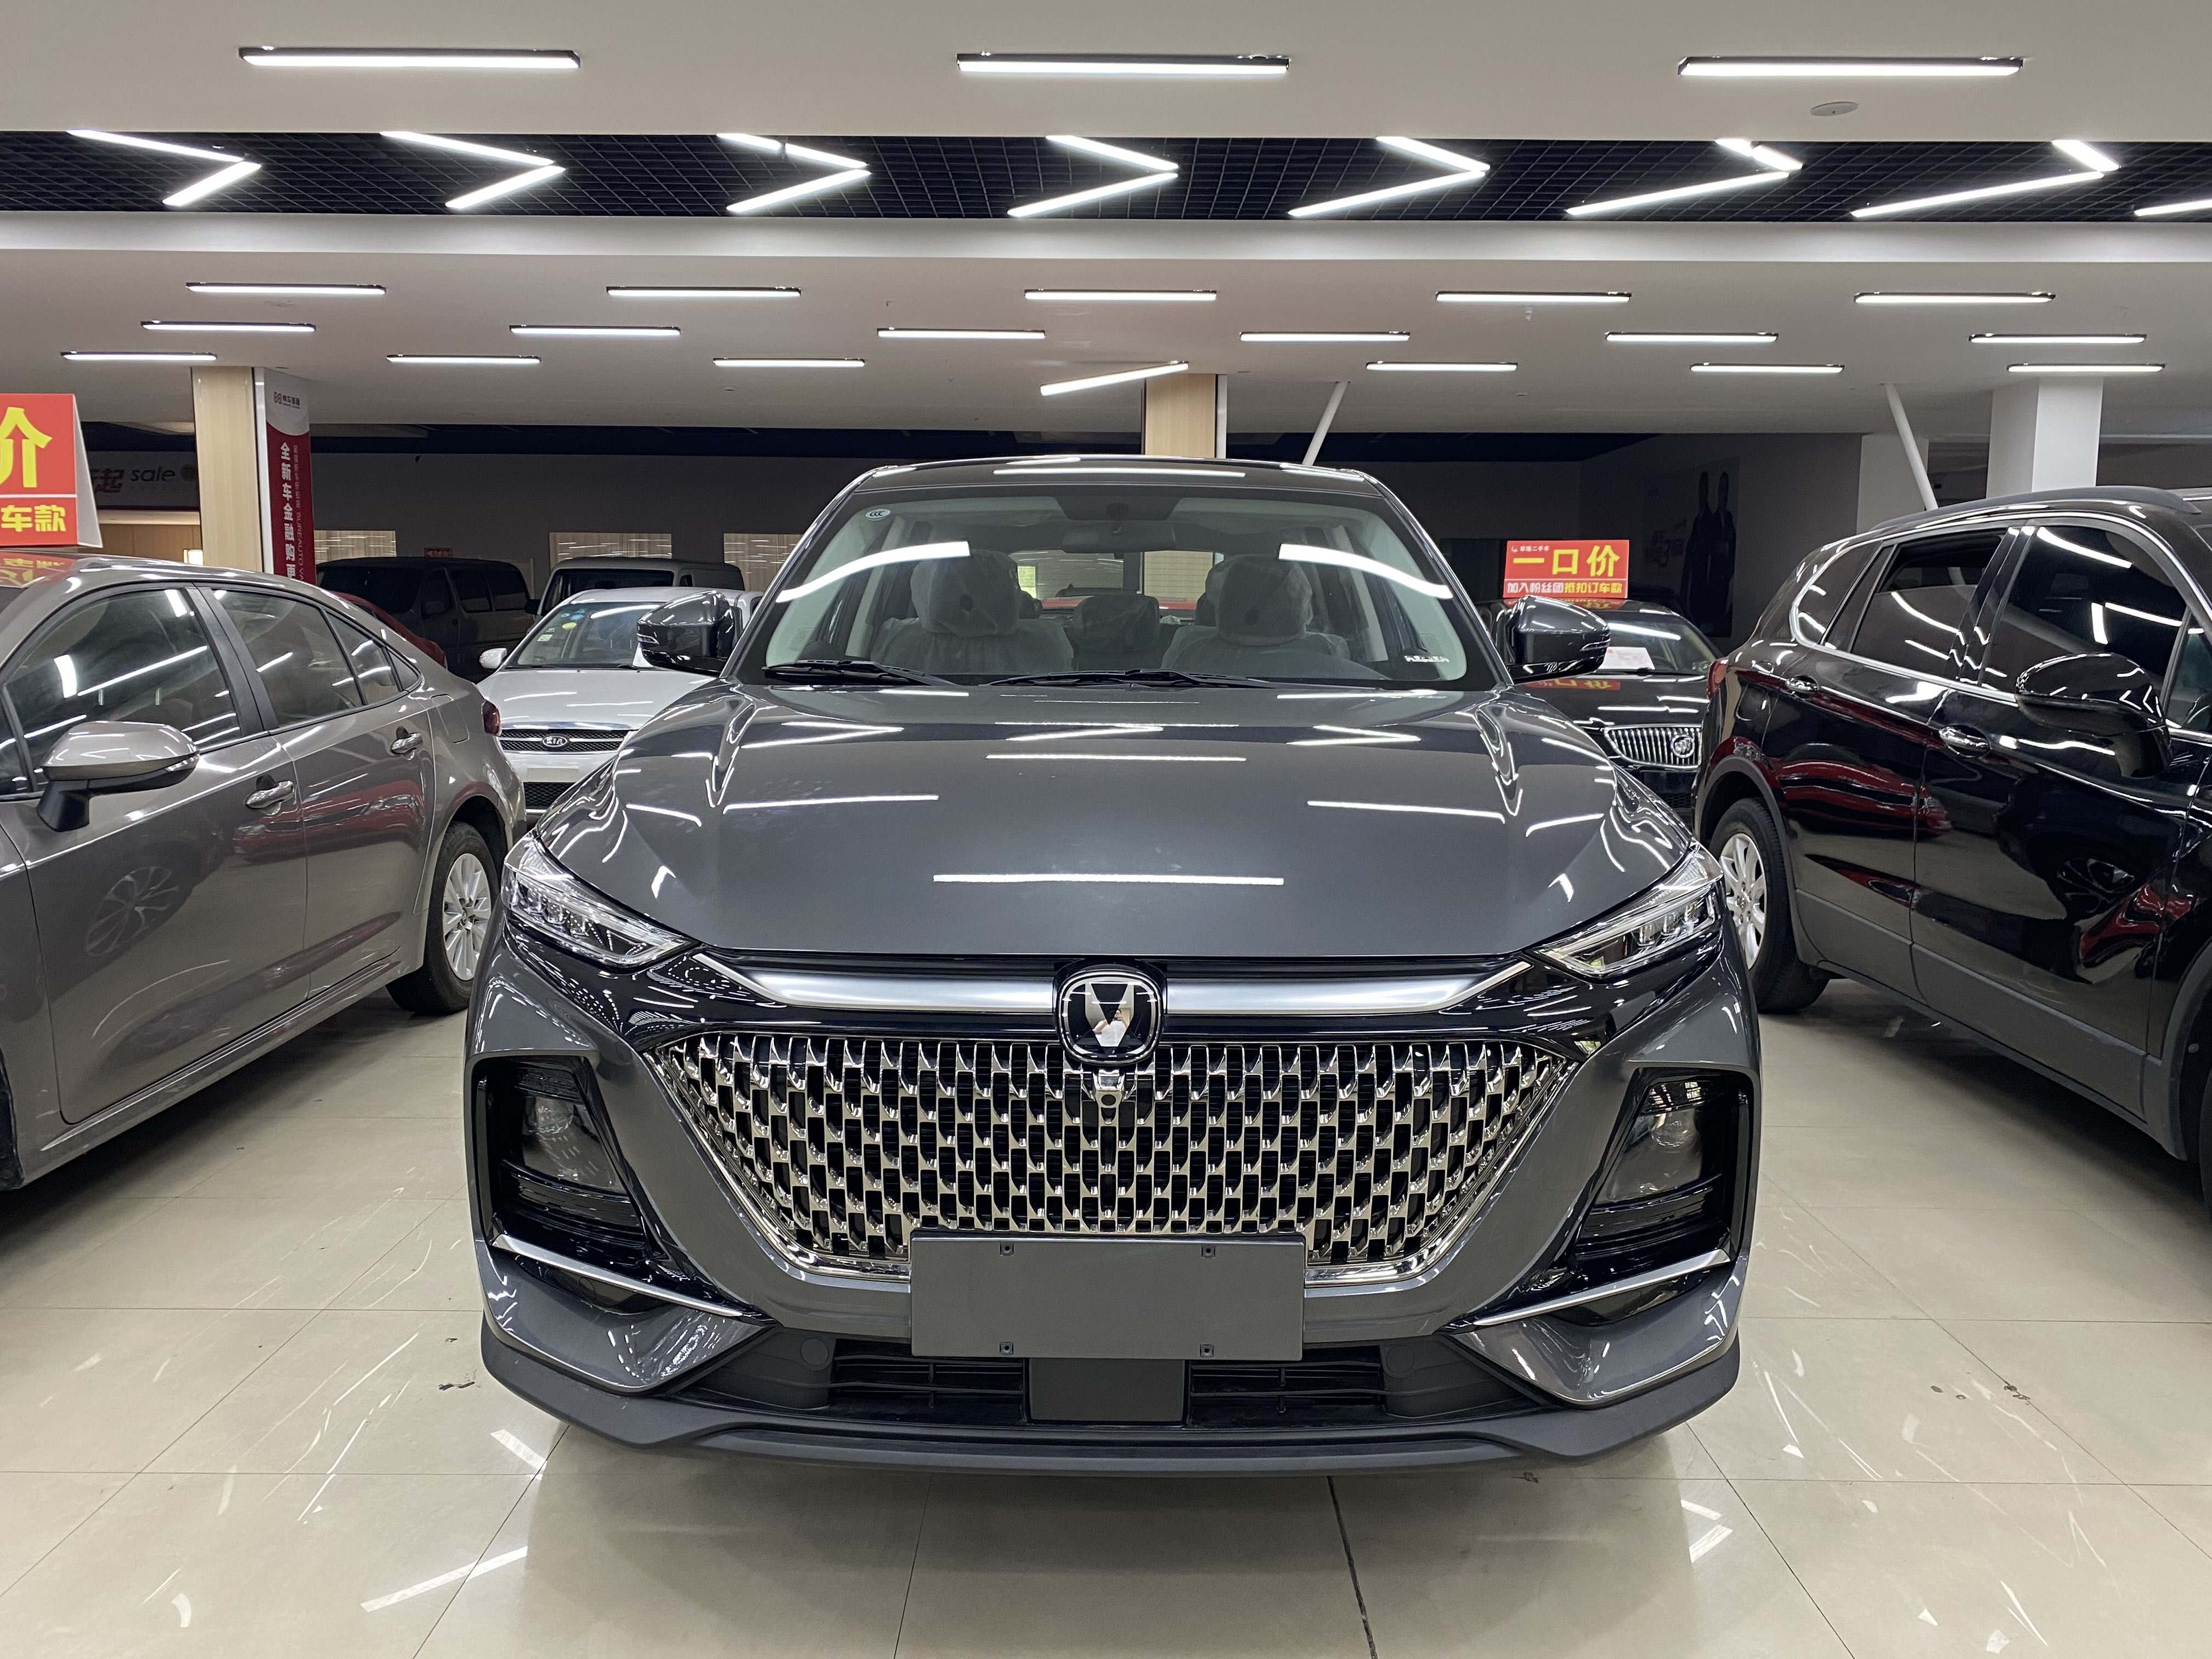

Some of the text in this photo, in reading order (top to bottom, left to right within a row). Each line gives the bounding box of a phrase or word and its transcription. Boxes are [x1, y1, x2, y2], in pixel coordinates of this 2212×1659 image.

[90, 468, 125, 493] 起
[130, 466, 176, 482] sale
[1, 505, 66, 532] 车款
[1513, 545, 1621, 577] 一口价
[546, 737, 563, 745] KIA
